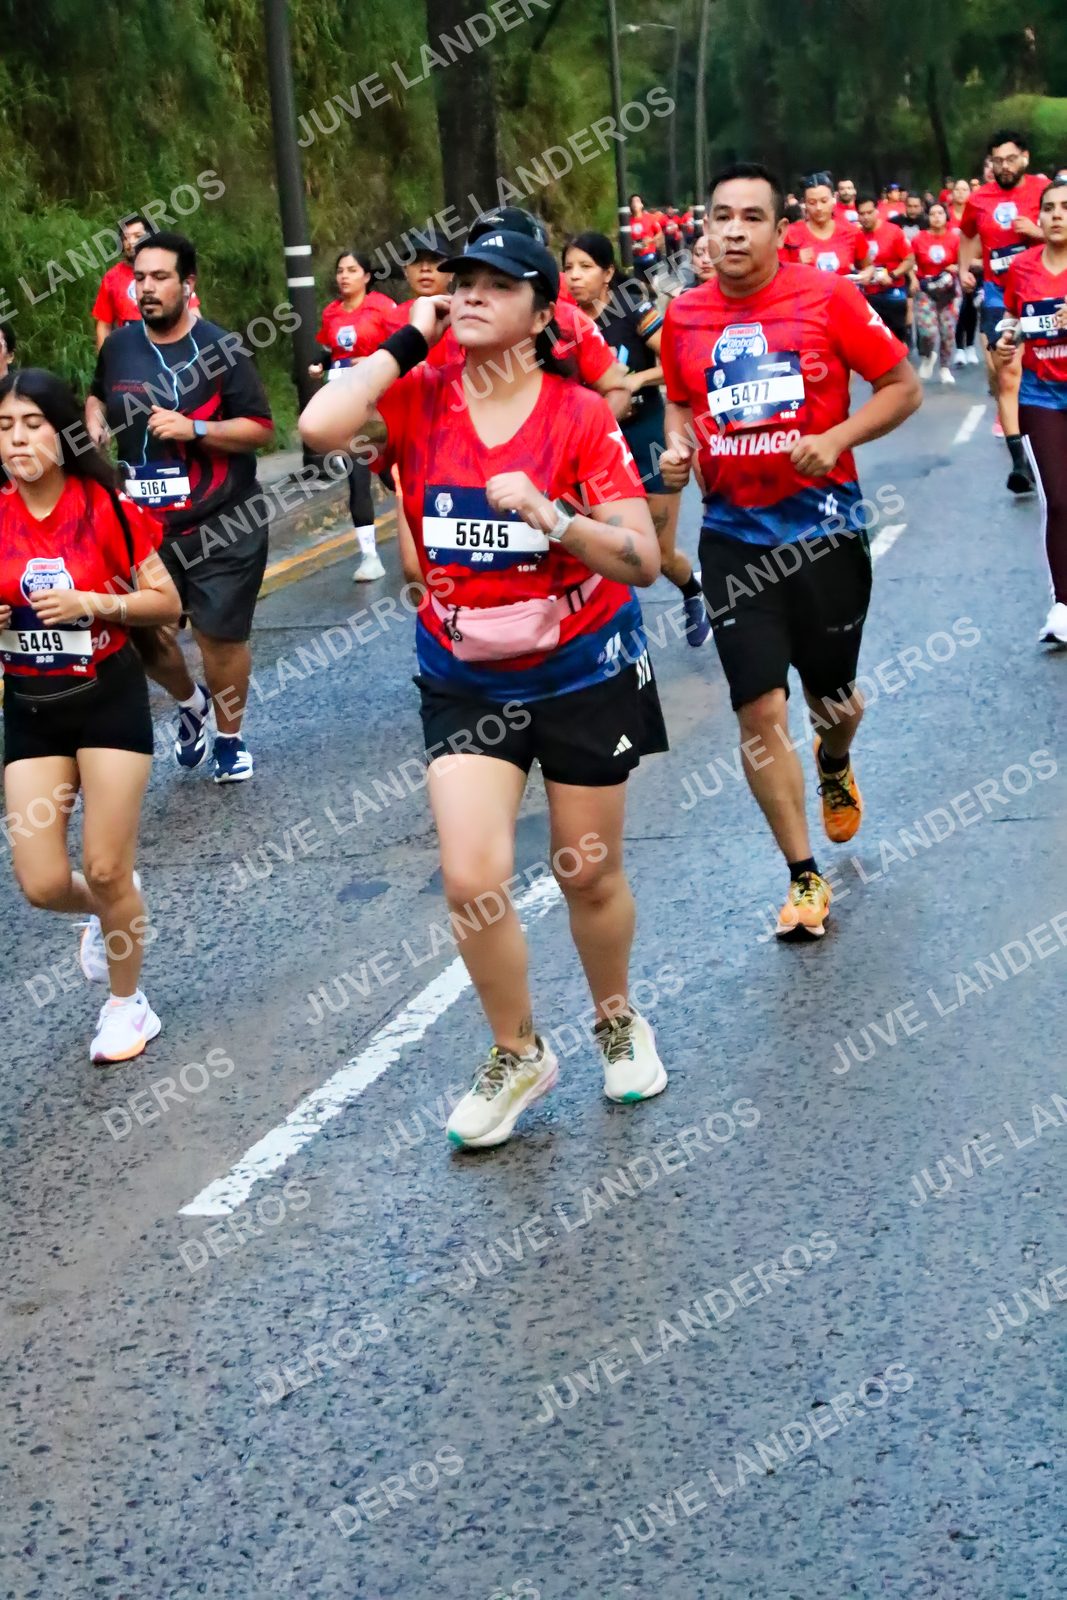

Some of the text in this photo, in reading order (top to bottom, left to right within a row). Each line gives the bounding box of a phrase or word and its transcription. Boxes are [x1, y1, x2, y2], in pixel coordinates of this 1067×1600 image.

[731, 381, 770, 406] 5477
[710, 429, 800, 456] SANTIAGO
[140, 480, 168, 496] 5164
[456, 521, 509, 549] 5545
[517, 564, 538, 572] 10K
[18, 631, 64, 653] 5449
